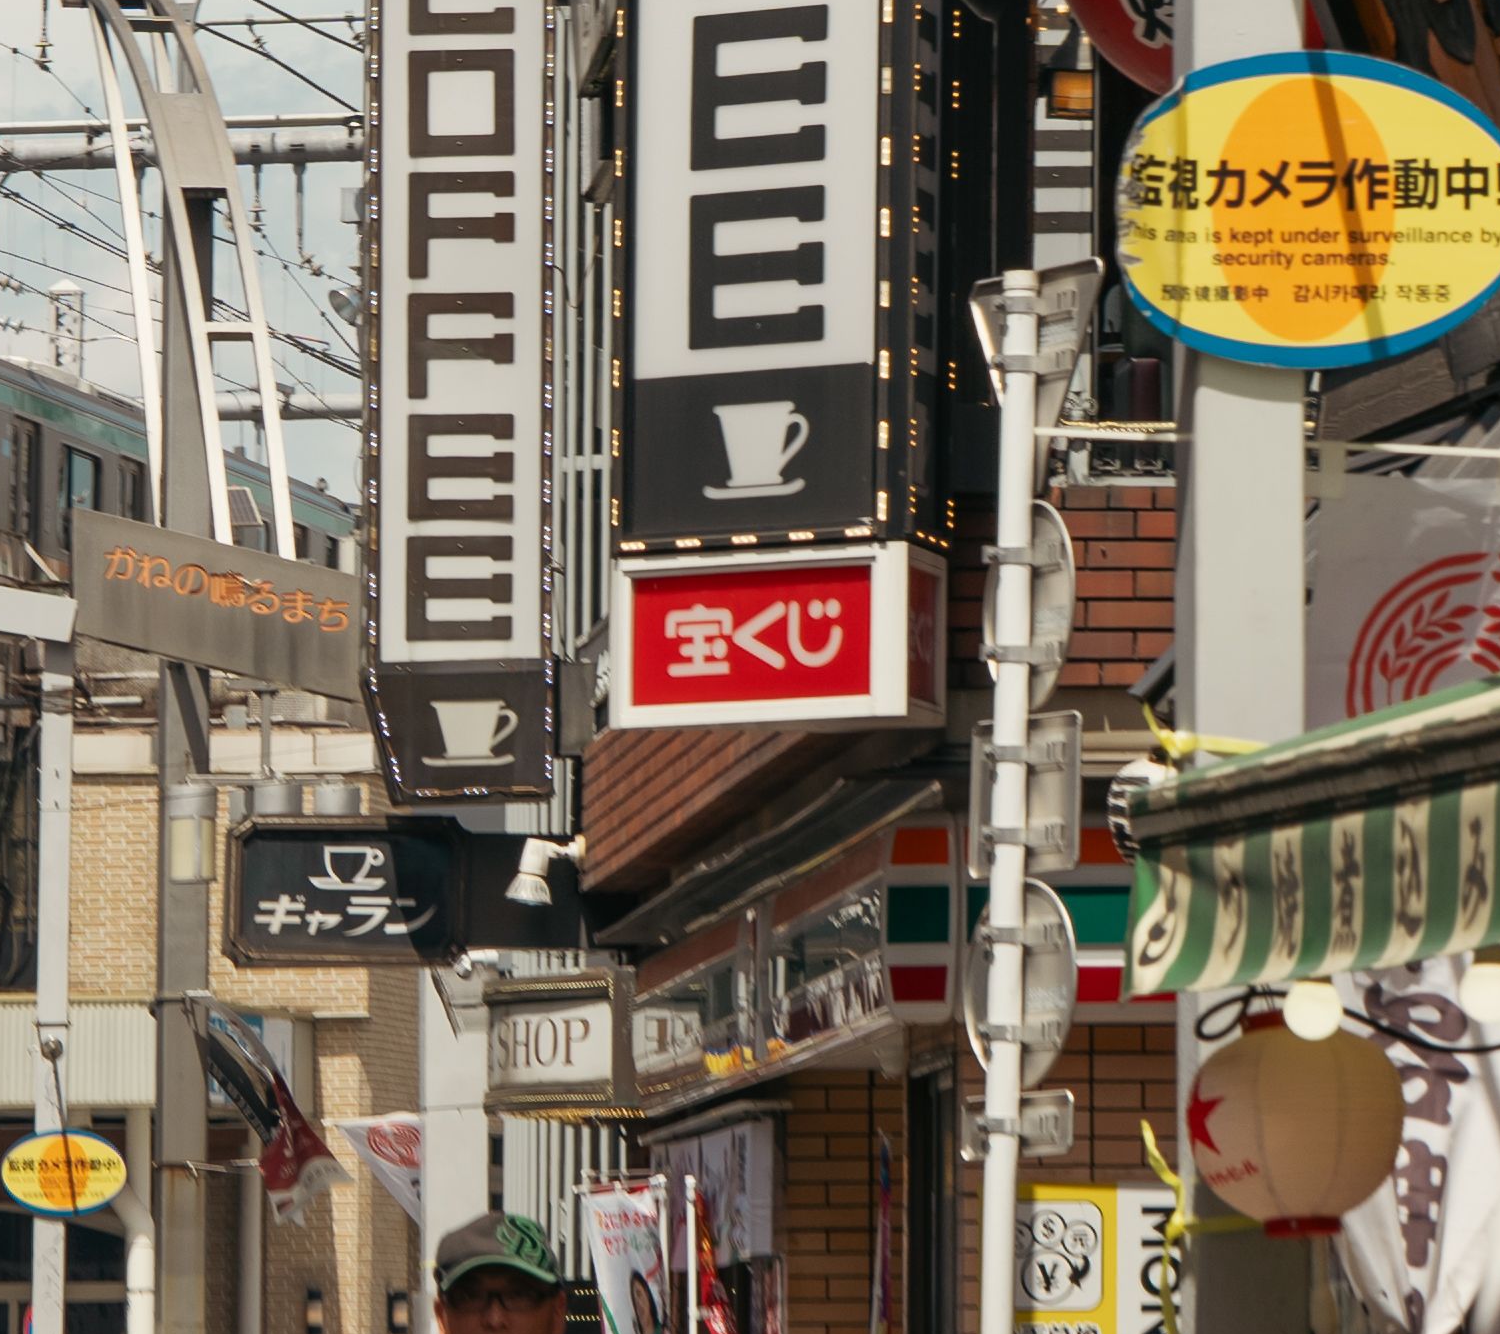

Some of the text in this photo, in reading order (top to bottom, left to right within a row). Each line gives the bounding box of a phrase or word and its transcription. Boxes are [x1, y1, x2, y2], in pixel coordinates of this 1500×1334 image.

[1212, 250, 1295, 270] security
[1229, 226, 1275, 249] kept
[1280, 226, 1340, 245] under
[102, 544, 350, 634] かねの鳴るまち
[664, 601, 844, 679] 宝くじ
[253, 892, 439, 938] ギャラン
[496, 1016, 592, 1069] SHOP
